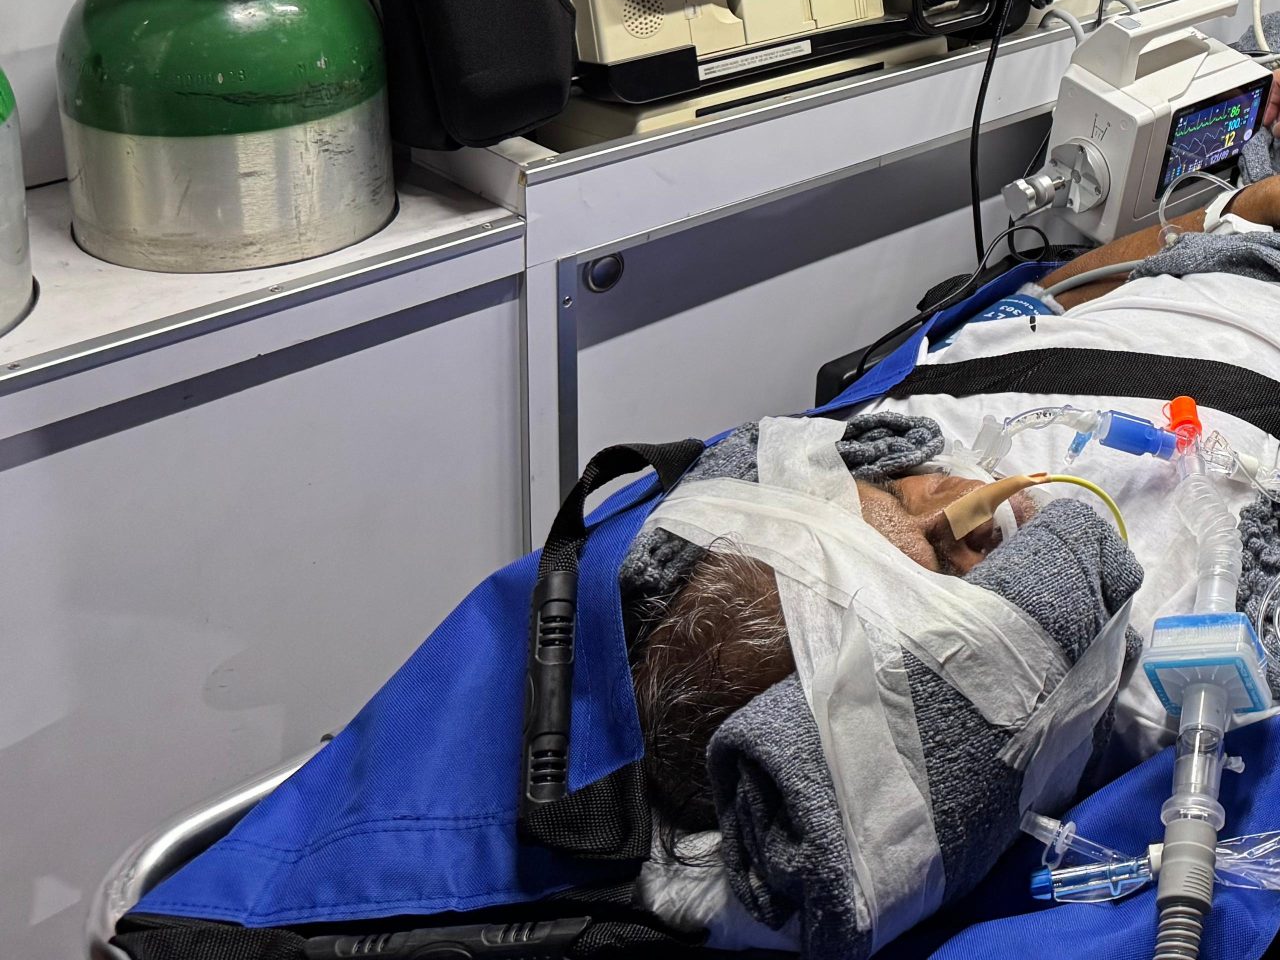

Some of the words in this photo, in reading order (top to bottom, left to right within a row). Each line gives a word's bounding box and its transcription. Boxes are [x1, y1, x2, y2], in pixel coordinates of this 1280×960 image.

[1230, 104, 1241, 117] 86
[1227, 117, 1241, 132] 100
[1224, 131, 1236, 148] 12
